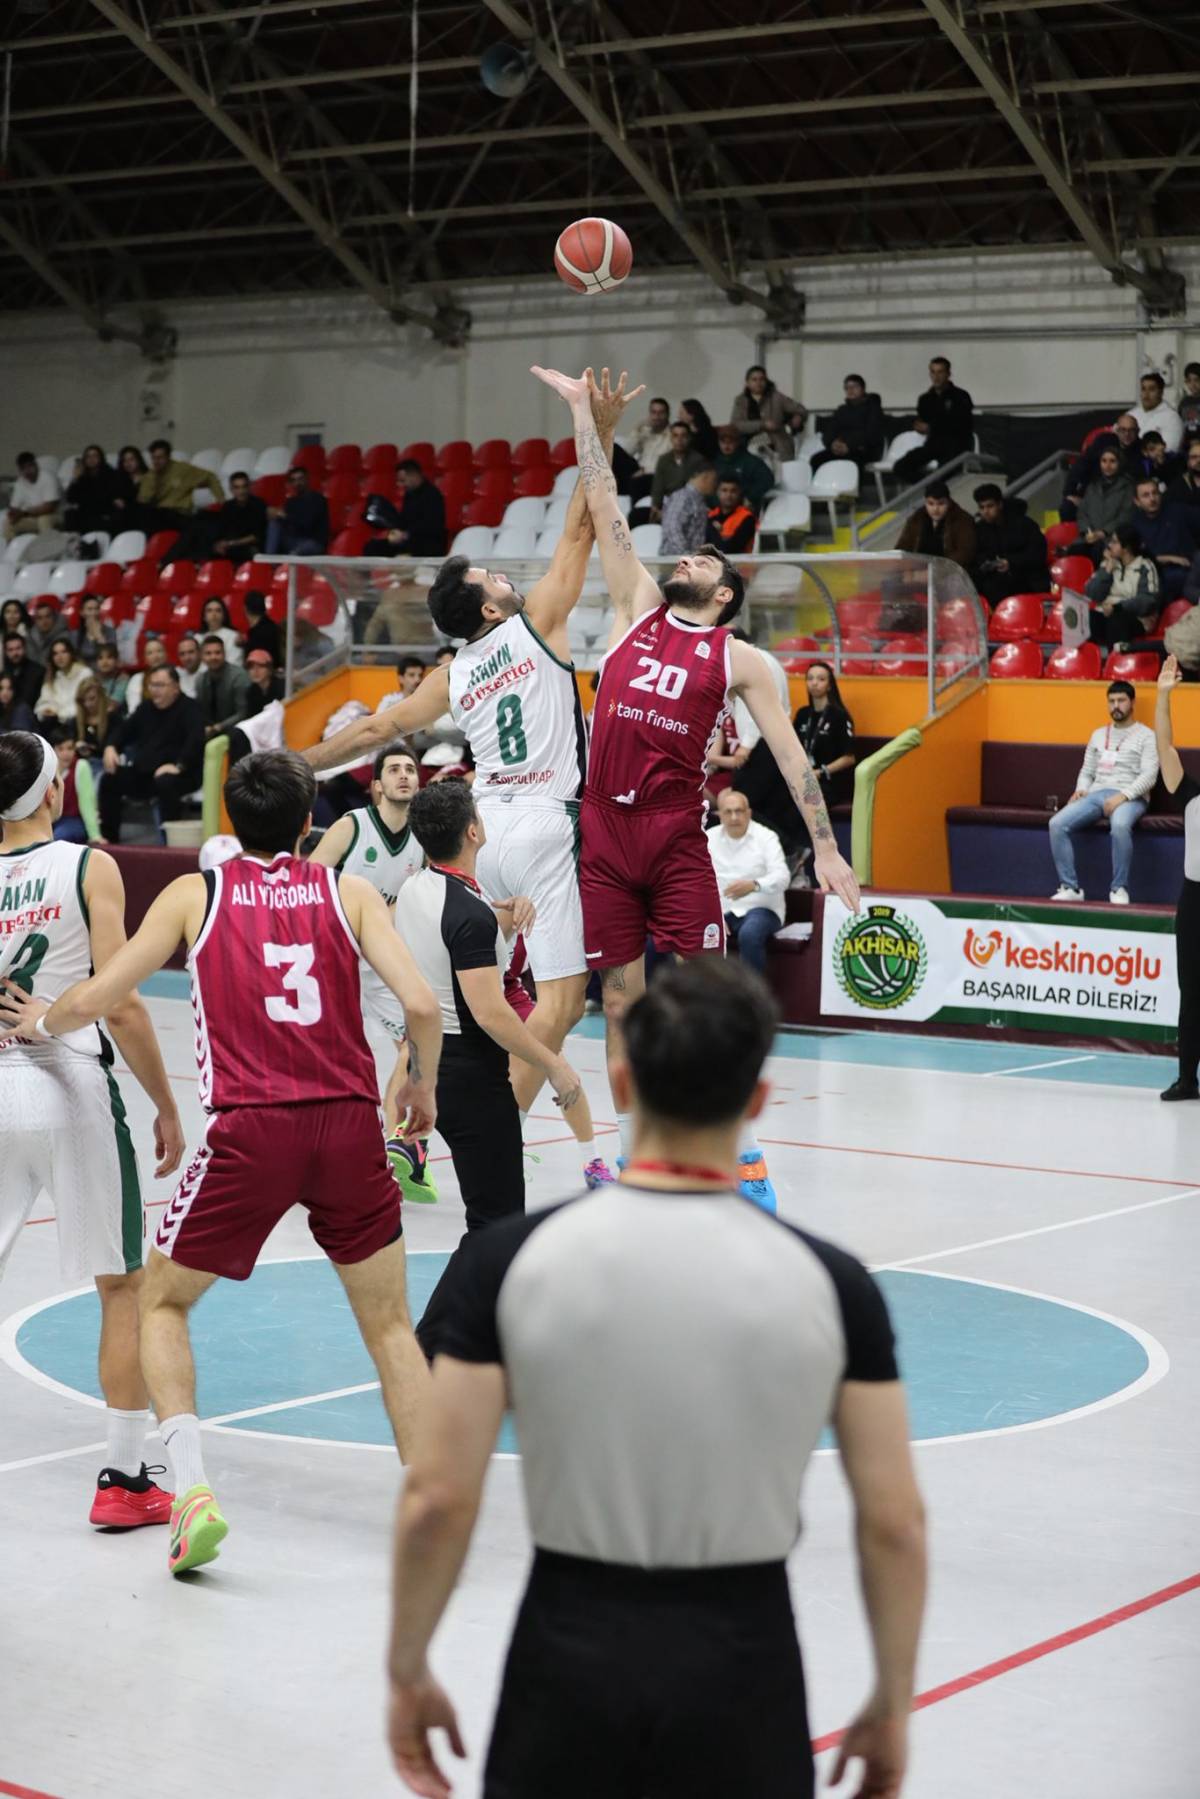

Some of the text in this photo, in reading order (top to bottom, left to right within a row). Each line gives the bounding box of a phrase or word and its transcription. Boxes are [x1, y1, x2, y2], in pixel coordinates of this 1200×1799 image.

[629, 656, 688, 700] 20
[496, 693, 528, 766] 8
[617, 702, 689, 735] tam finans
[842, 934, 920, 963] AKHİSAR
[1005, 937, 1161, 986] keskinoğlu
[263, 942, 323, 1027] 3
[963, 979, 1158, 1013] BAŞARILAR DİLERİZ!
